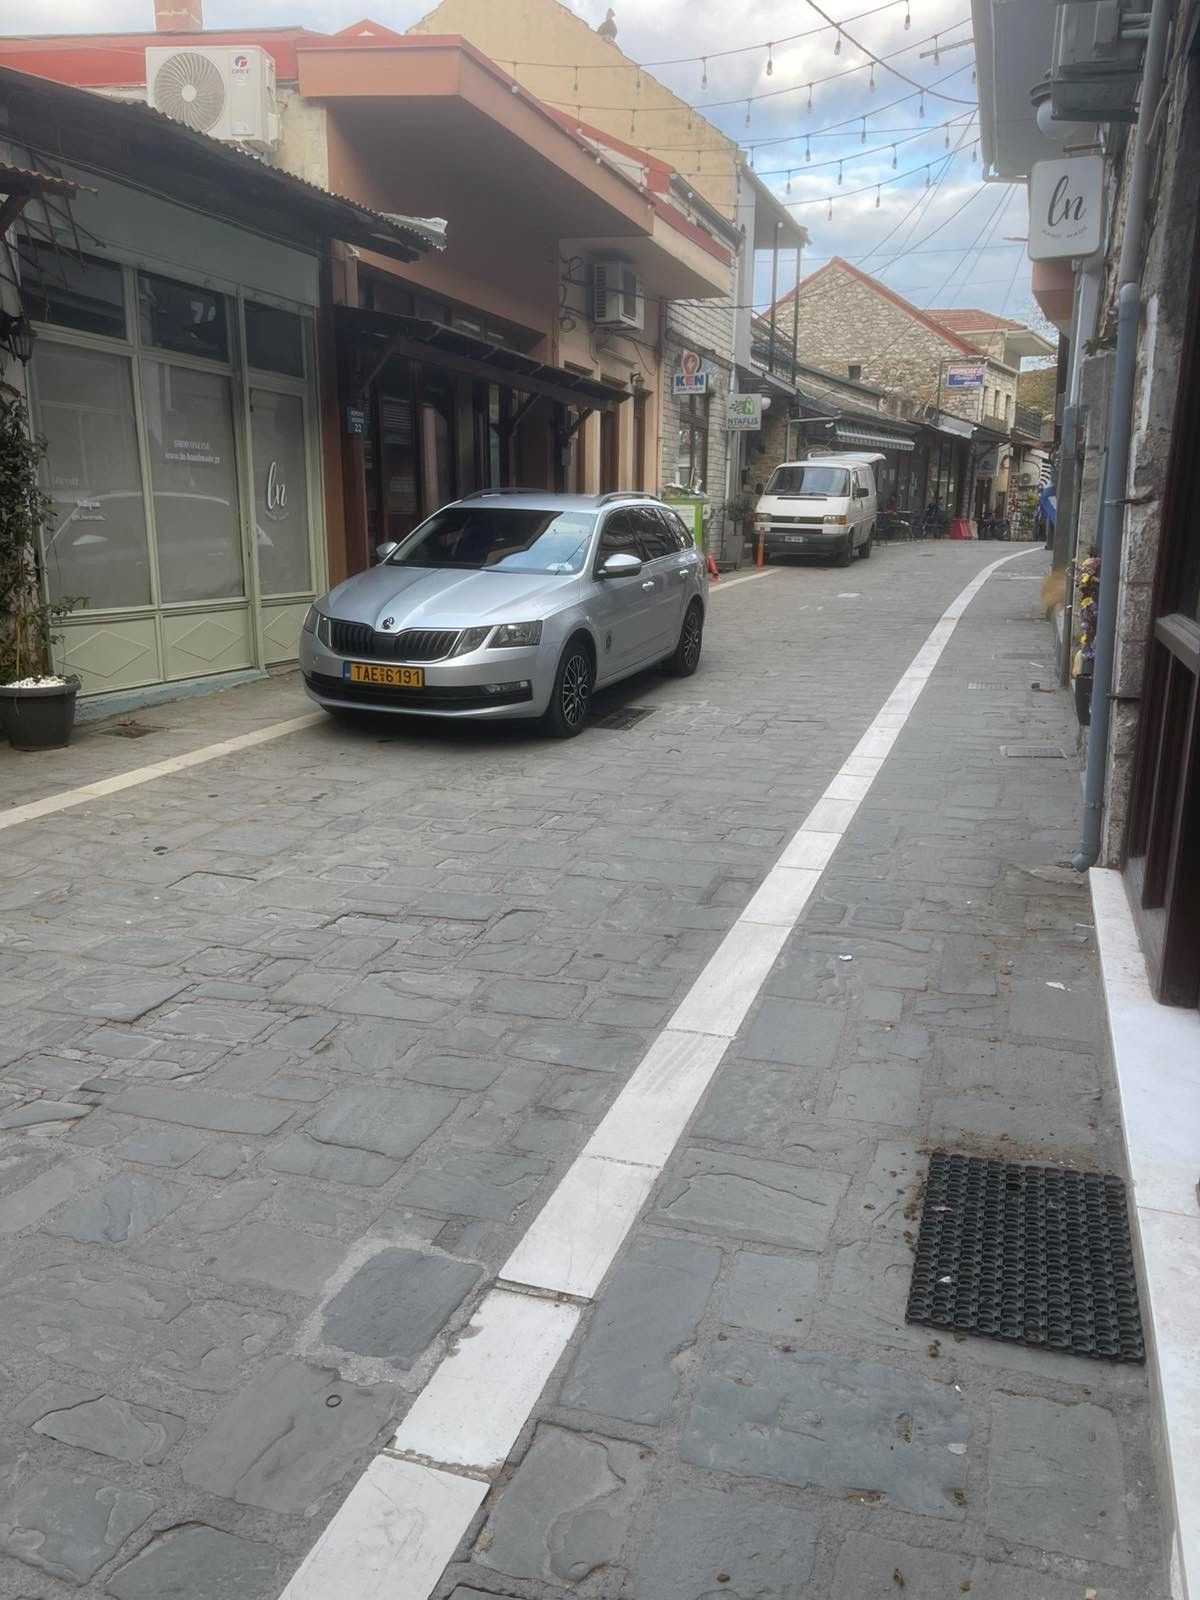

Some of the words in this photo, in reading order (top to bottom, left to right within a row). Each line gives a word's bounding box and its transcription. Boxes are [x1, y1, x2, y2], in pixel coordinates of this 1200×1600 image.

[1047, 174, 1087, 227] ln
[727, 417, 759, 425] NTAFLIS
[267, 461, 288, 510] ln
